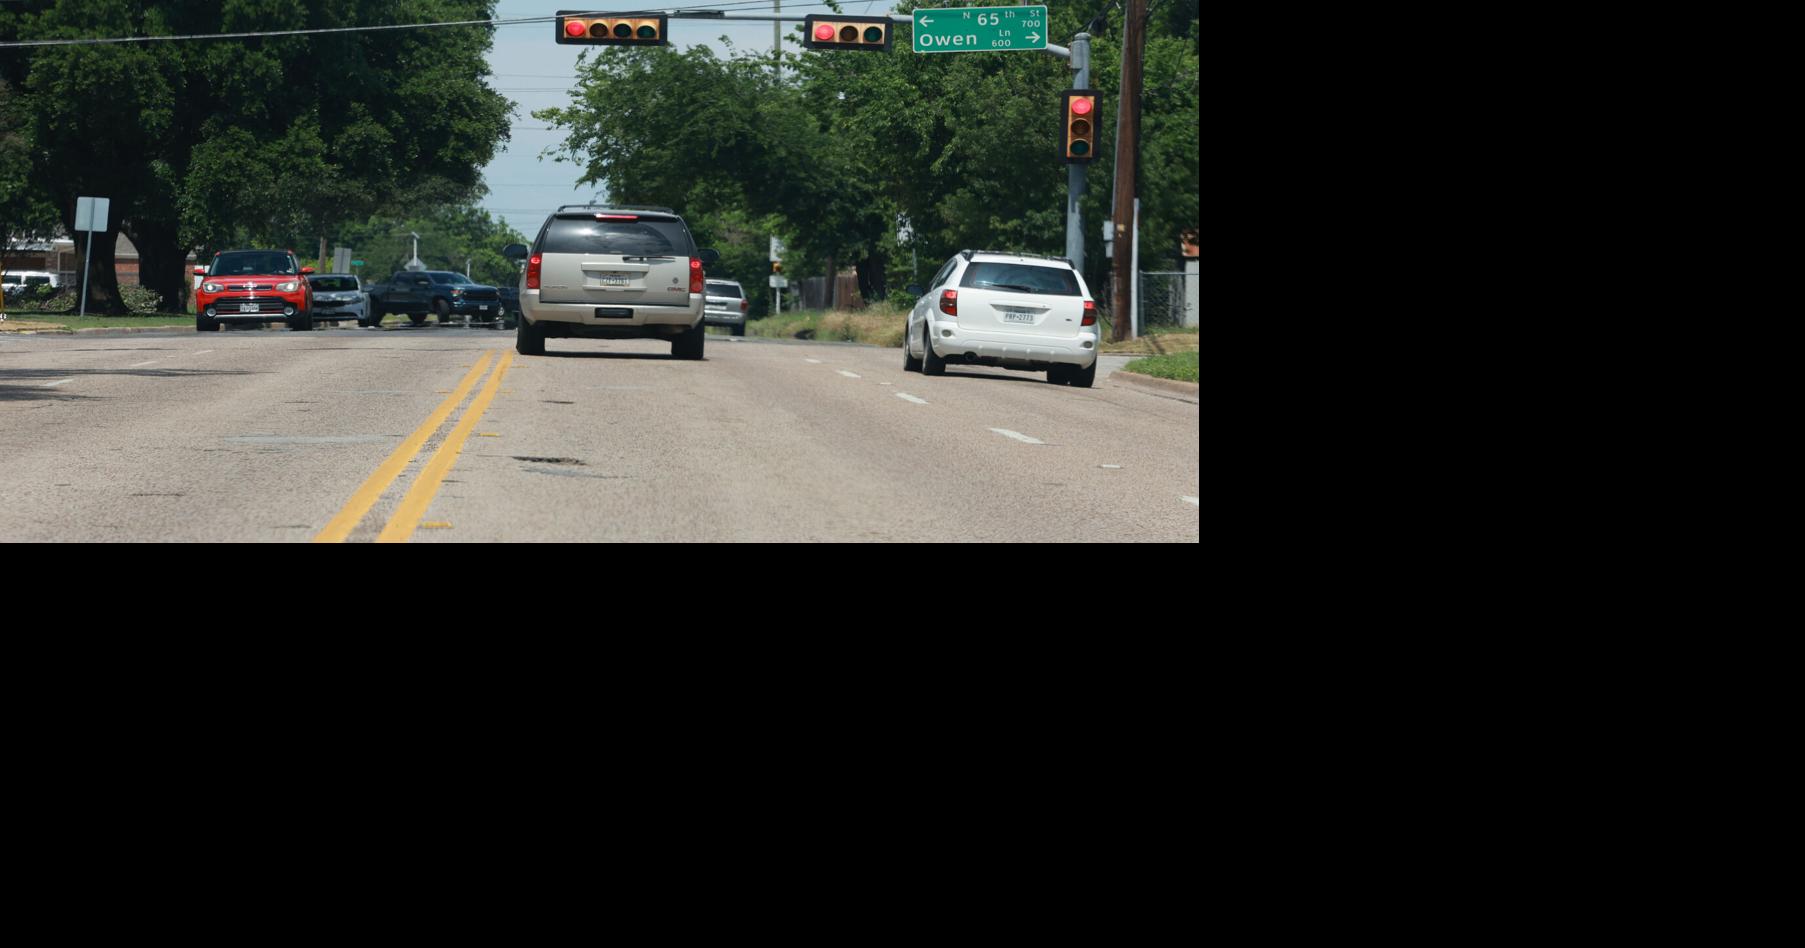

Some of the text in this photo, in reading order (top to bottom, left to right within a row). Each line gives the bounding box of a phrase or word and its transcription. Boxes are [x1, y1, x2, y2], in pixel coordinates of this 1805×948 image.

[977, 13, 999, 26] 65
[1022, 20, 1040, 28] 700
[919, 29, 1010, 47] Owen Ln
